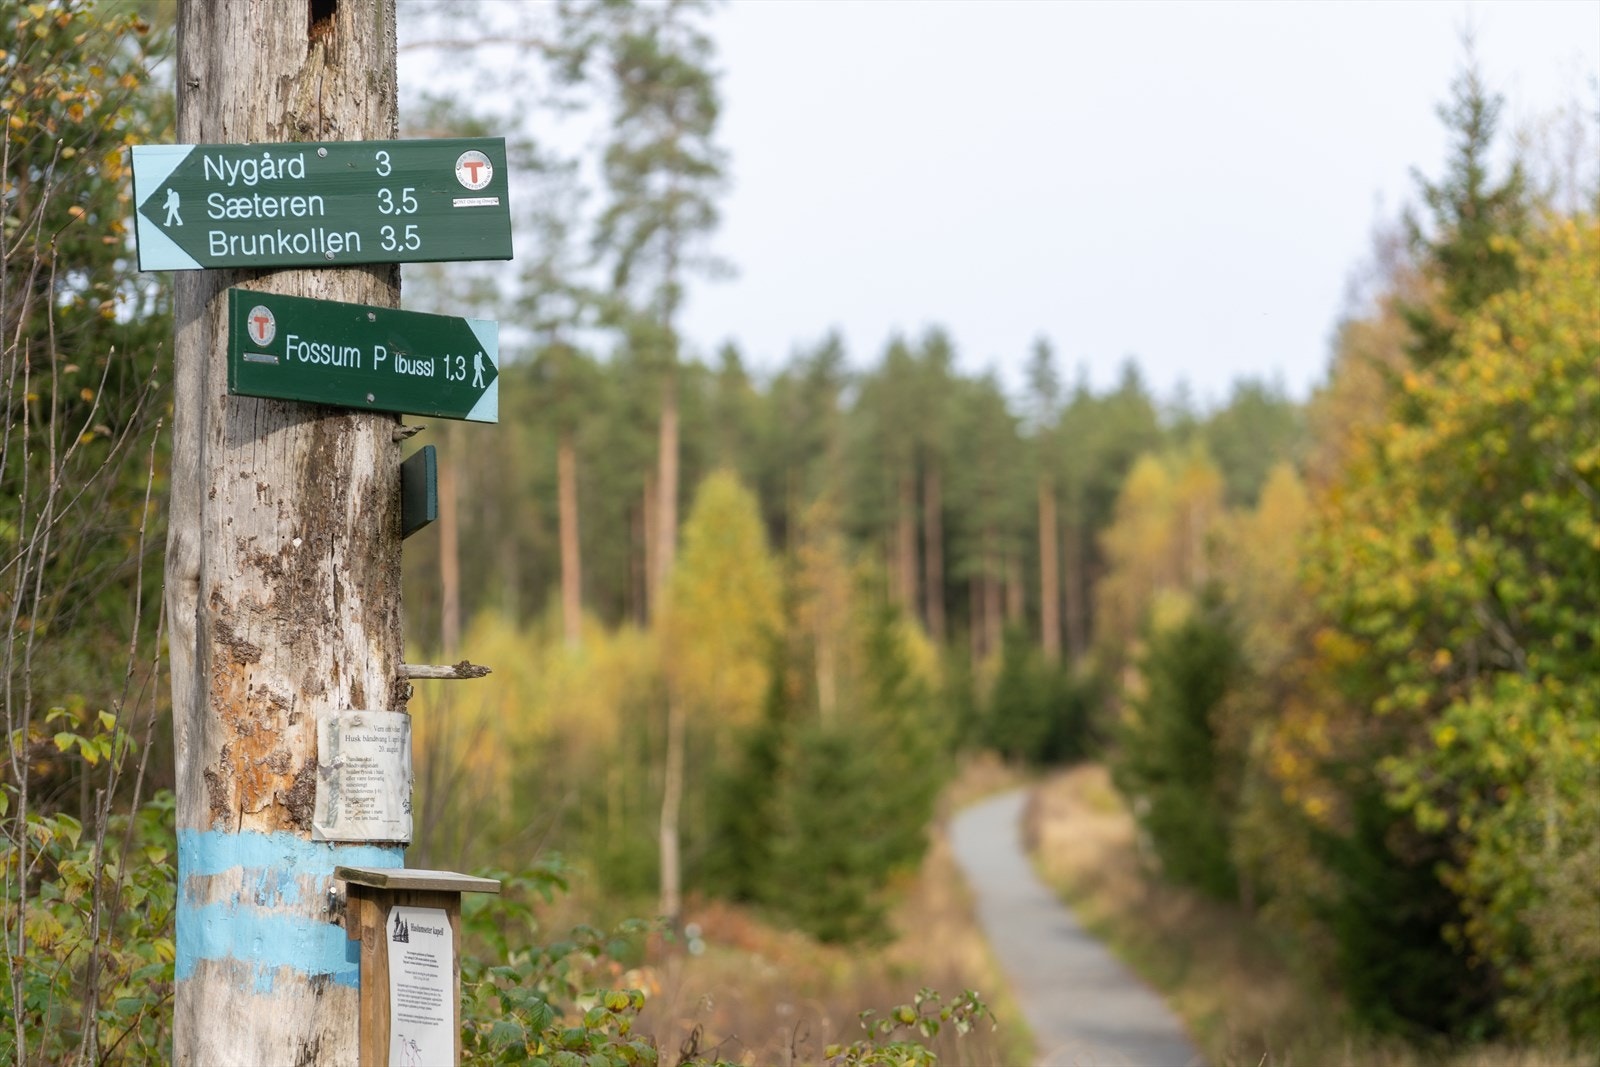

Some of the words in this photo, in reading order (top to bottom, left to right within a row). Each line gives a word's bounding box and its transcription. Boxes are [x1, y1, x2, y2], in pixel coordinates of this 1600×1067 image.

[203, 152, 305, 187] Nygård
[375, 151, 392, 177] 3
[207, 192, 325, 219] Sæteren
[377, 187, 418, 215] 3,5
[208, 227, 361, 257] Brunkollen
[380, 224, 421, 252] 3,5
[286, 334, 361, 369] Fossum
[373, 345, 387, 370] P
[394, 354, 435, 377] (buss)
[443, 354, 466, 381] 1,3
